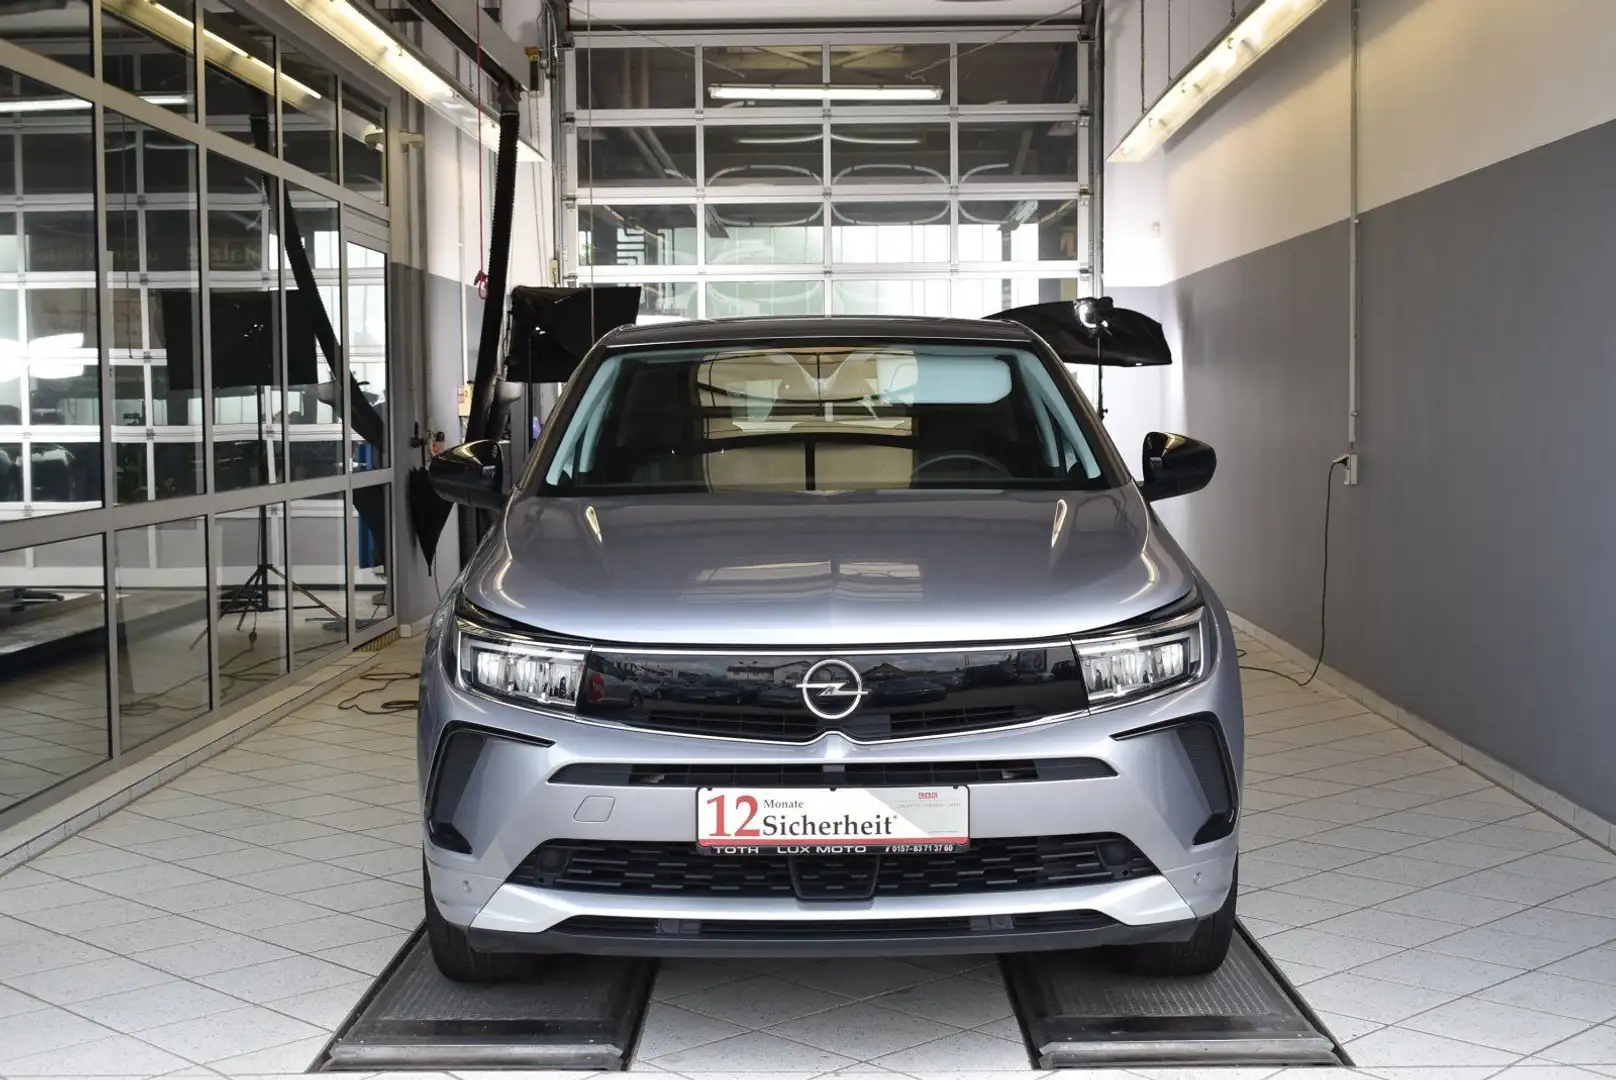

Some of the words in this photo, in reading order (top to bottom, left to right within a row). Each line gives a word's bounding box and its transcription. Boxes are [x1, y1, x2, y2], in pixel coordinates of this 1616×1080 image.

[763, 799, 804, 809] Monate
[707, 794, 760, 837] 12
[714, 846, 759, 854] TOTH
[777, 846, 810, 854] LUX
[816, 845, 867, 854] MOTO
